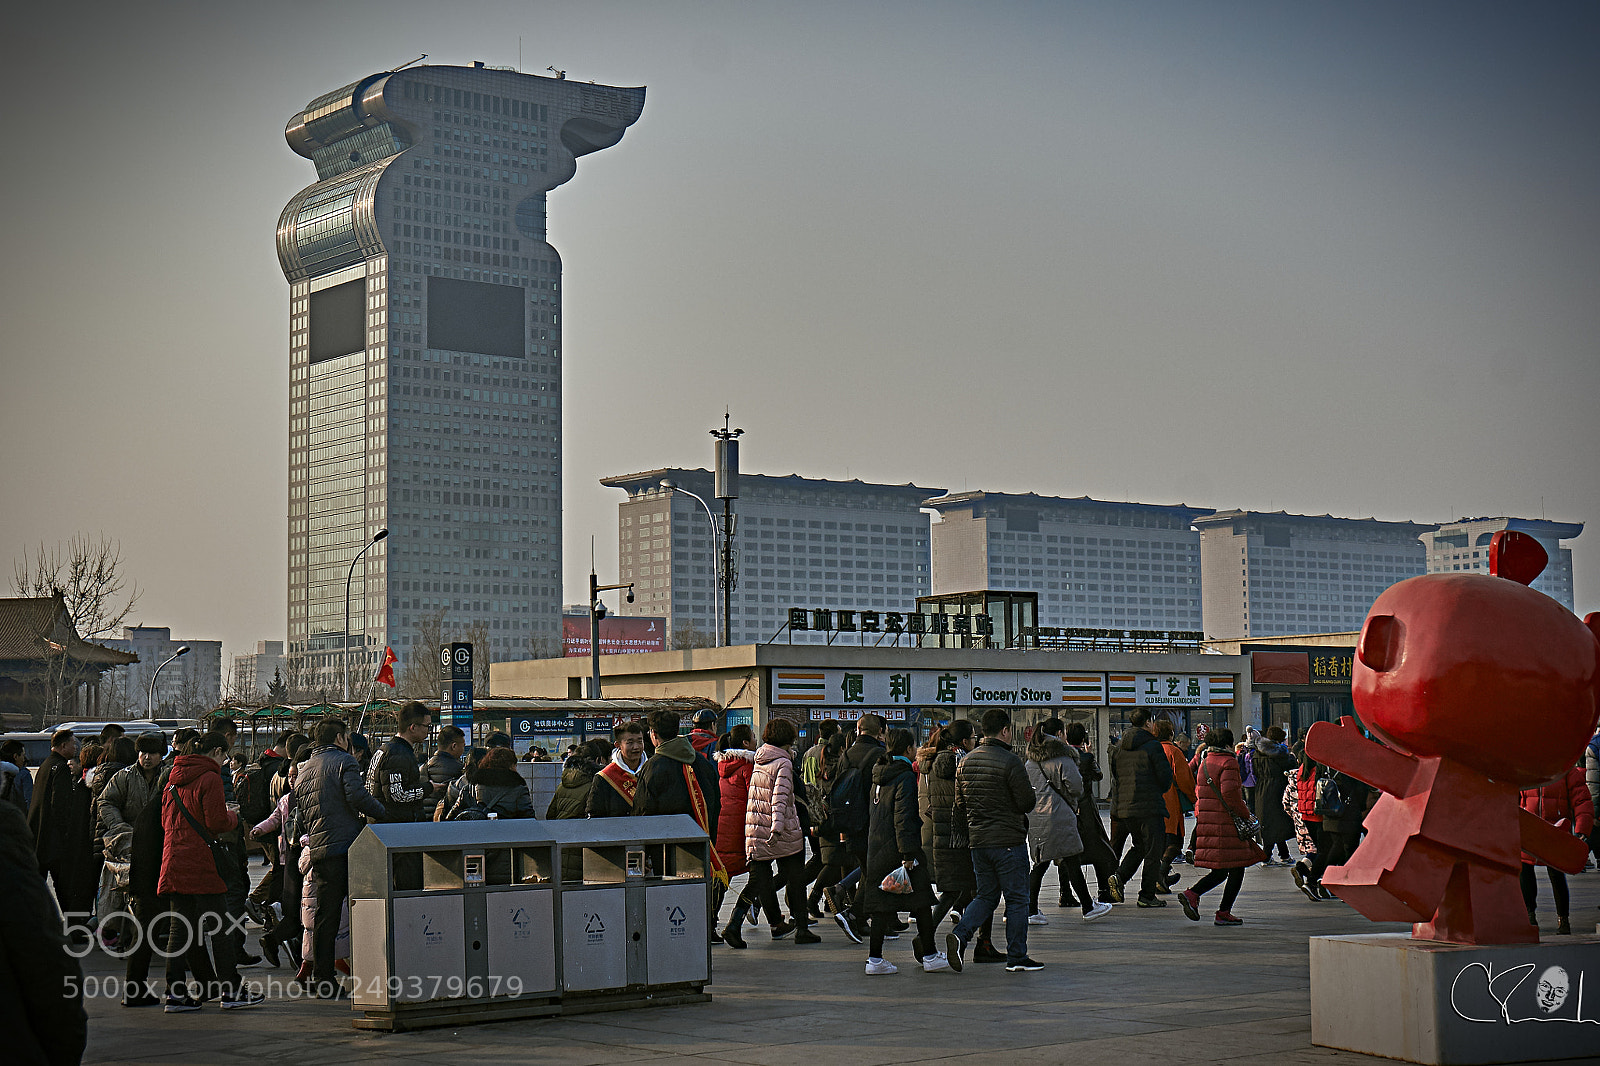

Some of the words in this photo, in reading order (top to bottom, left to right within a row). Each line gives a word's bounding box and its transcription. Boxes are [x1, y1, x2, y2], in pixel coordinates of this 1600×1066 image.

[790, 608, 993, 634] 奥林匹克公园服务站
[1313, 656, 1352, 677] 稻香村
[841, 672, 957, 702] 便利店
[972, 686, 1018, 704] Grocery
[1020, 687, 1052, 701] Store
[1145, 677, 1201, 697] 工艺品
[812, 710, 832, 720] 出口
[884, 710, 904, 720] 出口
